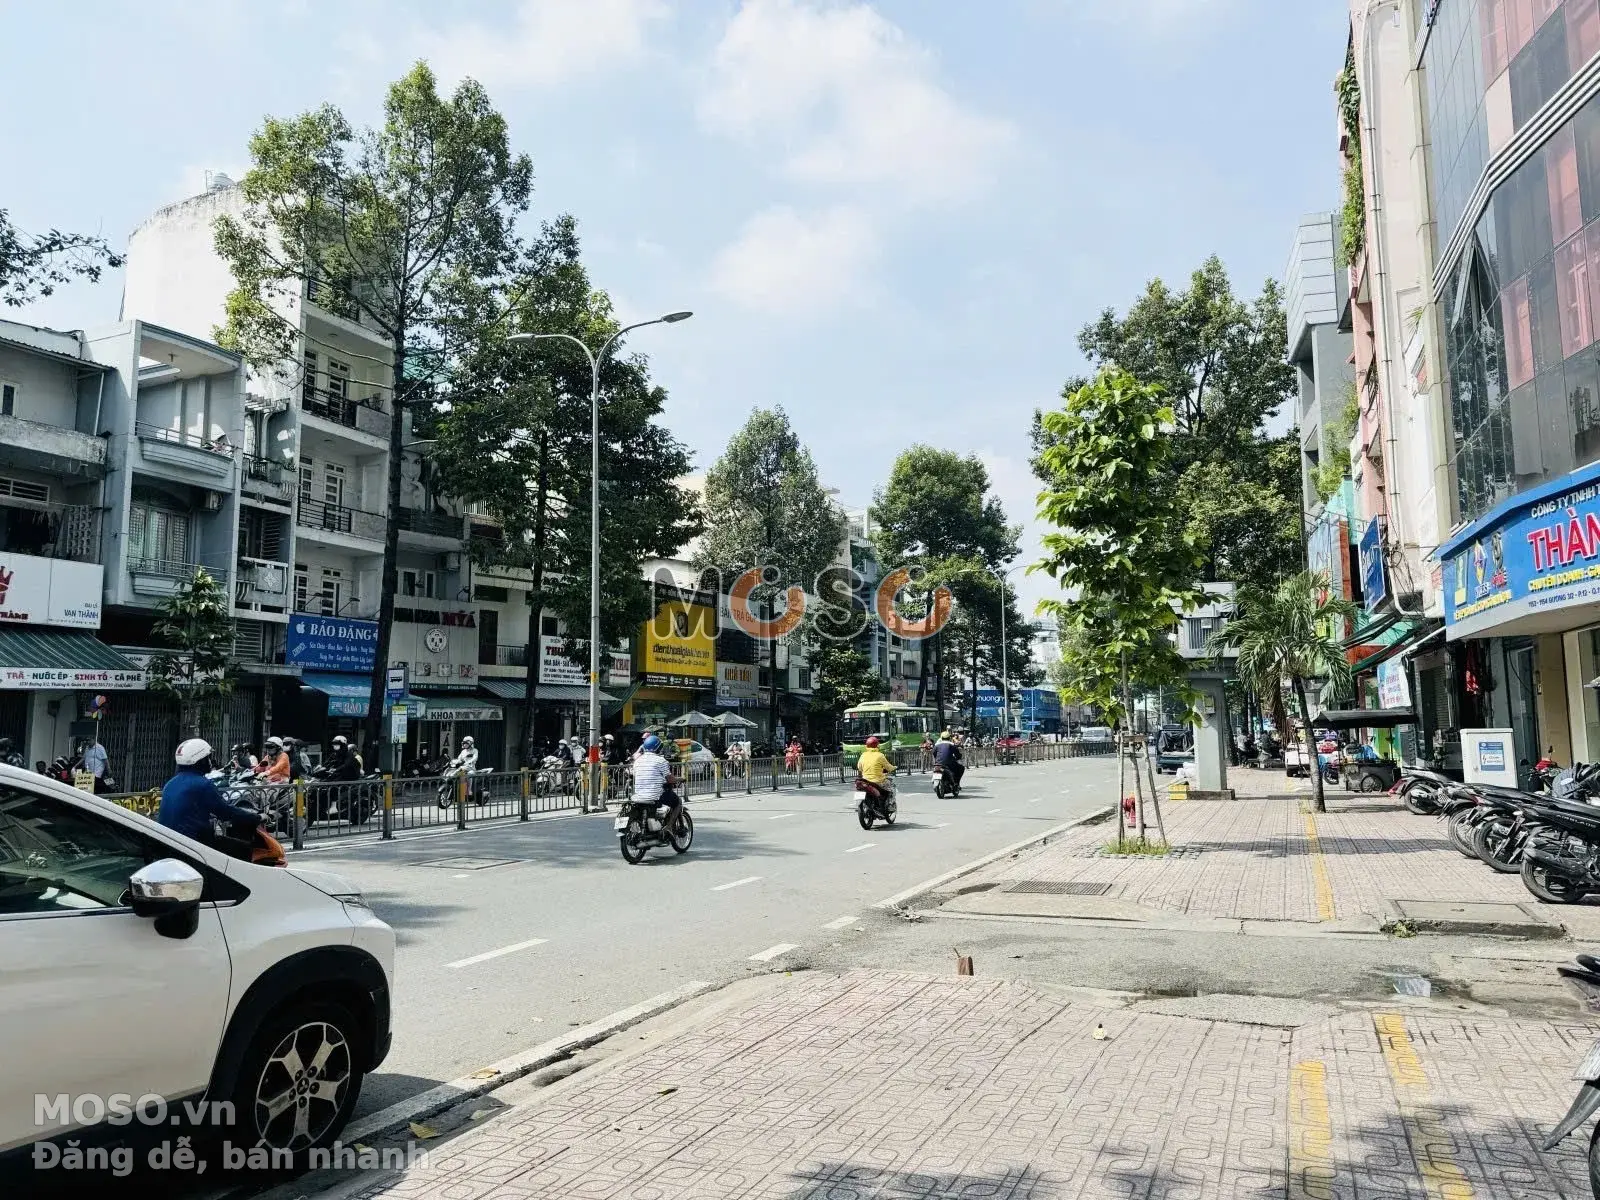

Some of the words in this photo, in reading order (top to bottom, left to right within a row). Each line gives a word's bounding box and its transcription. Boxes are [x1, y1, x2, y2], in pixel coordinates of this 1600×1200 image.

[1531, 502, 1556, 518] CÔNG
[1556, 495, 1568, 508] TY
[1569, 486, 1595, 503] TNHH
[310, 620, 336, 637] BẢO
[338, 625, 372, 642] ĐẶNG
[74, 673, 96, 681] SINH
[430, 711, 454, 720] KHOA
